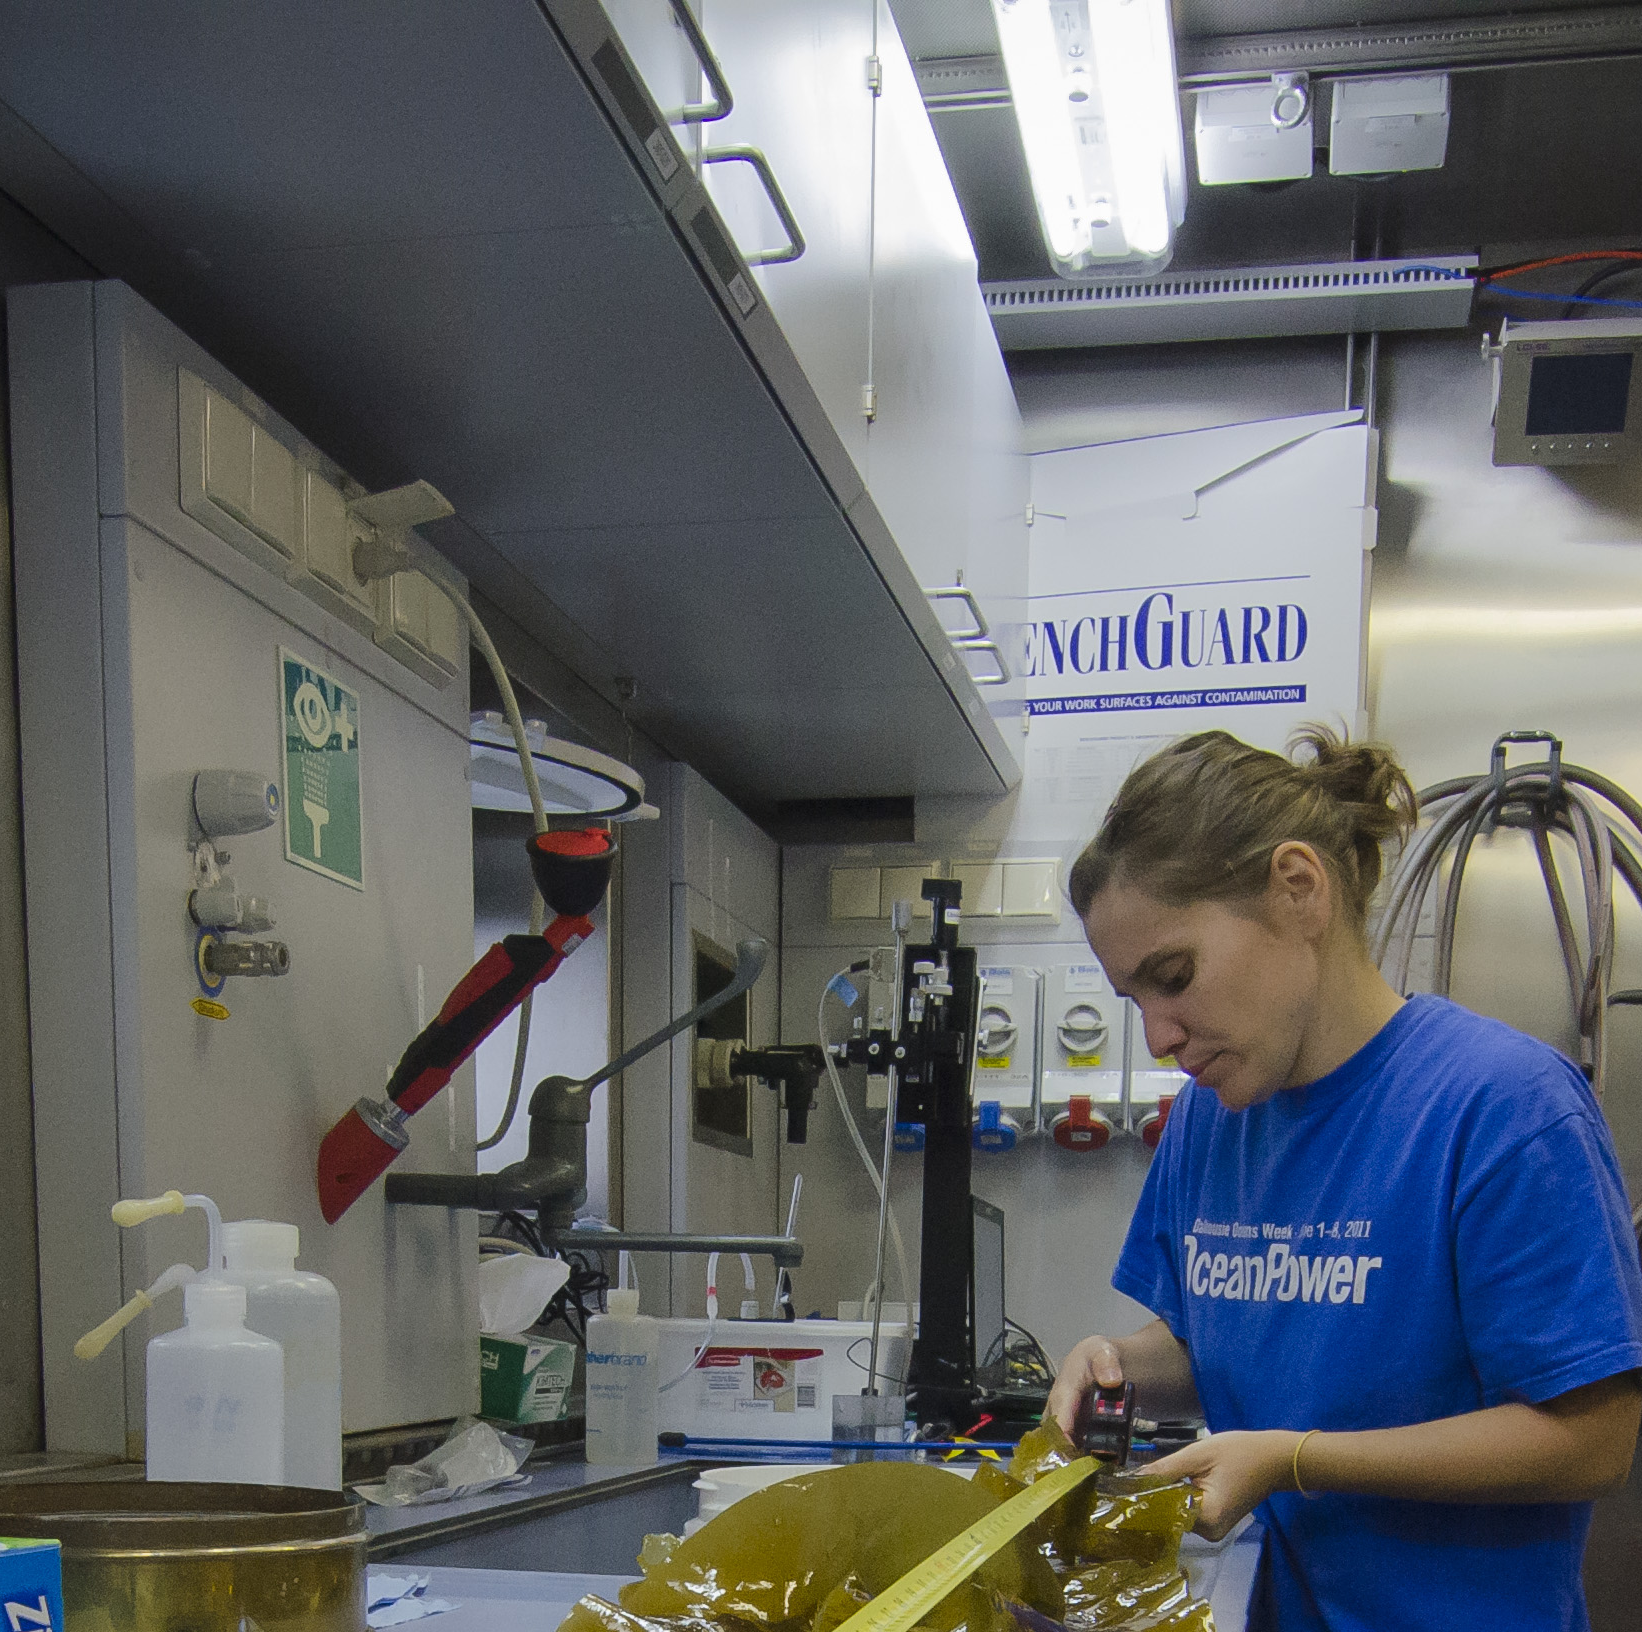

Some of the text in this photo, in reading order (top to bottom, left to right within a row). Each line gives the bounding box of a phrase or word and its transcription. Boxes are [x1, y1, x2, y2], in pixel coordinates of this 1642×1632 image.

[1024, 592, 1307, 678] ENCHGUARD
[1033, 701, 1062, 713] YOUR
[1064, 699, 1098, 711] WORK
[1100, 695, 1153, 709] SURFACES
[1155, 693, 1203, 706] AGAINST
[1205, 689, 1300, 705] CONTAMINATION
[1262, 1223, 1293, 1239] Week
[1344, 1220, 1372, 1238] 2011
